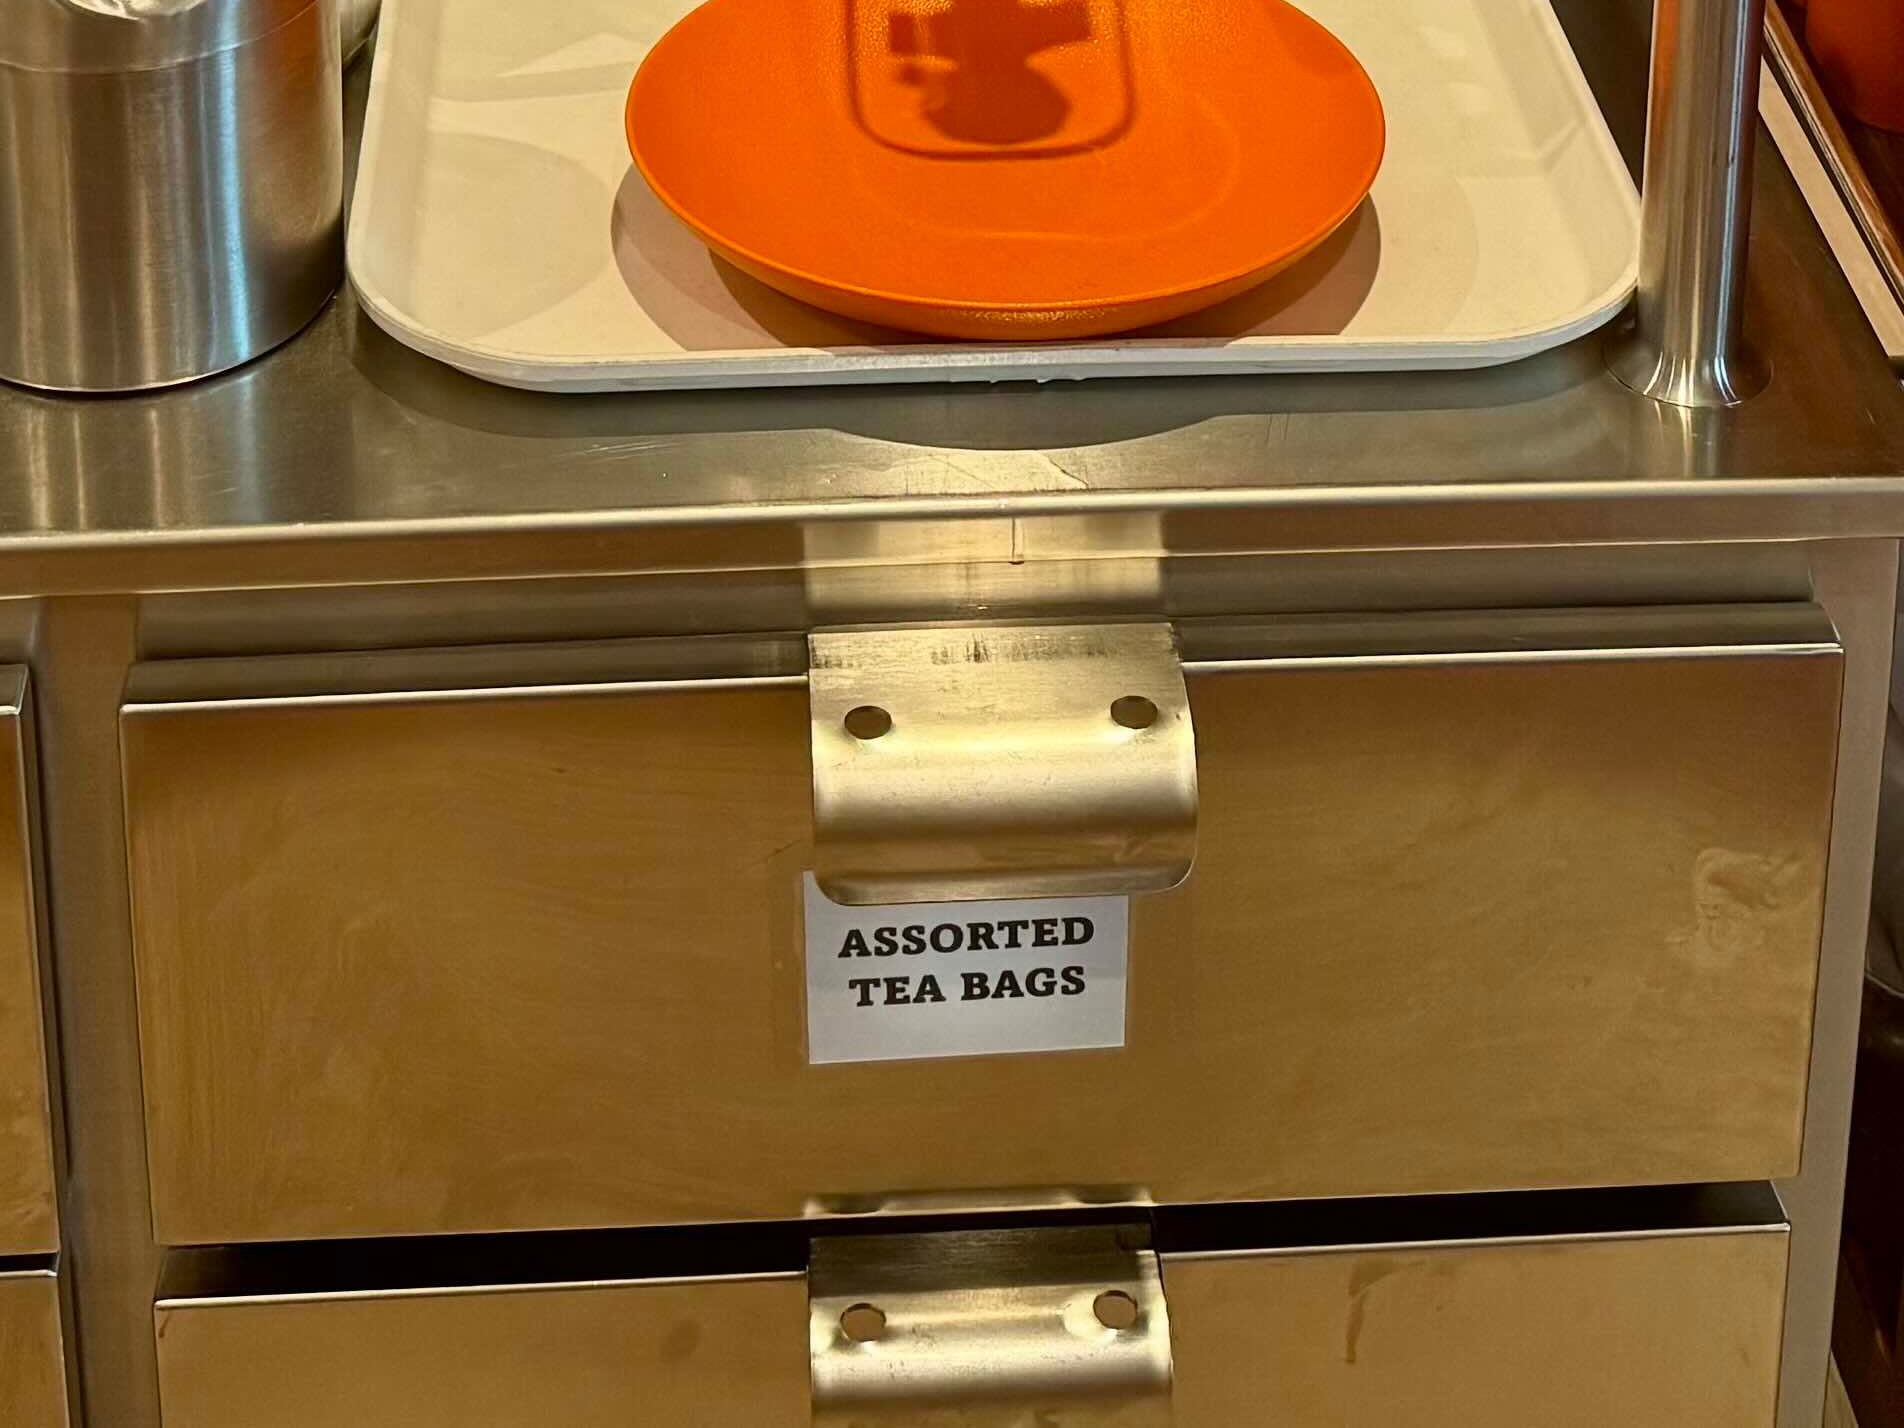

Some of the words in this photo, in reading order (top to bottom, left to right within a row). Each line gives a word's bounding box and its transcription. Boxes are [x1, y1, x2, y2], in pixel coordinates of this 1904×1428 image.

[837, 916, 1095, 959] ASSORTED
[848, 974, 947, 1007] TEA
[960, 966, 1086, 1001] BAGS
